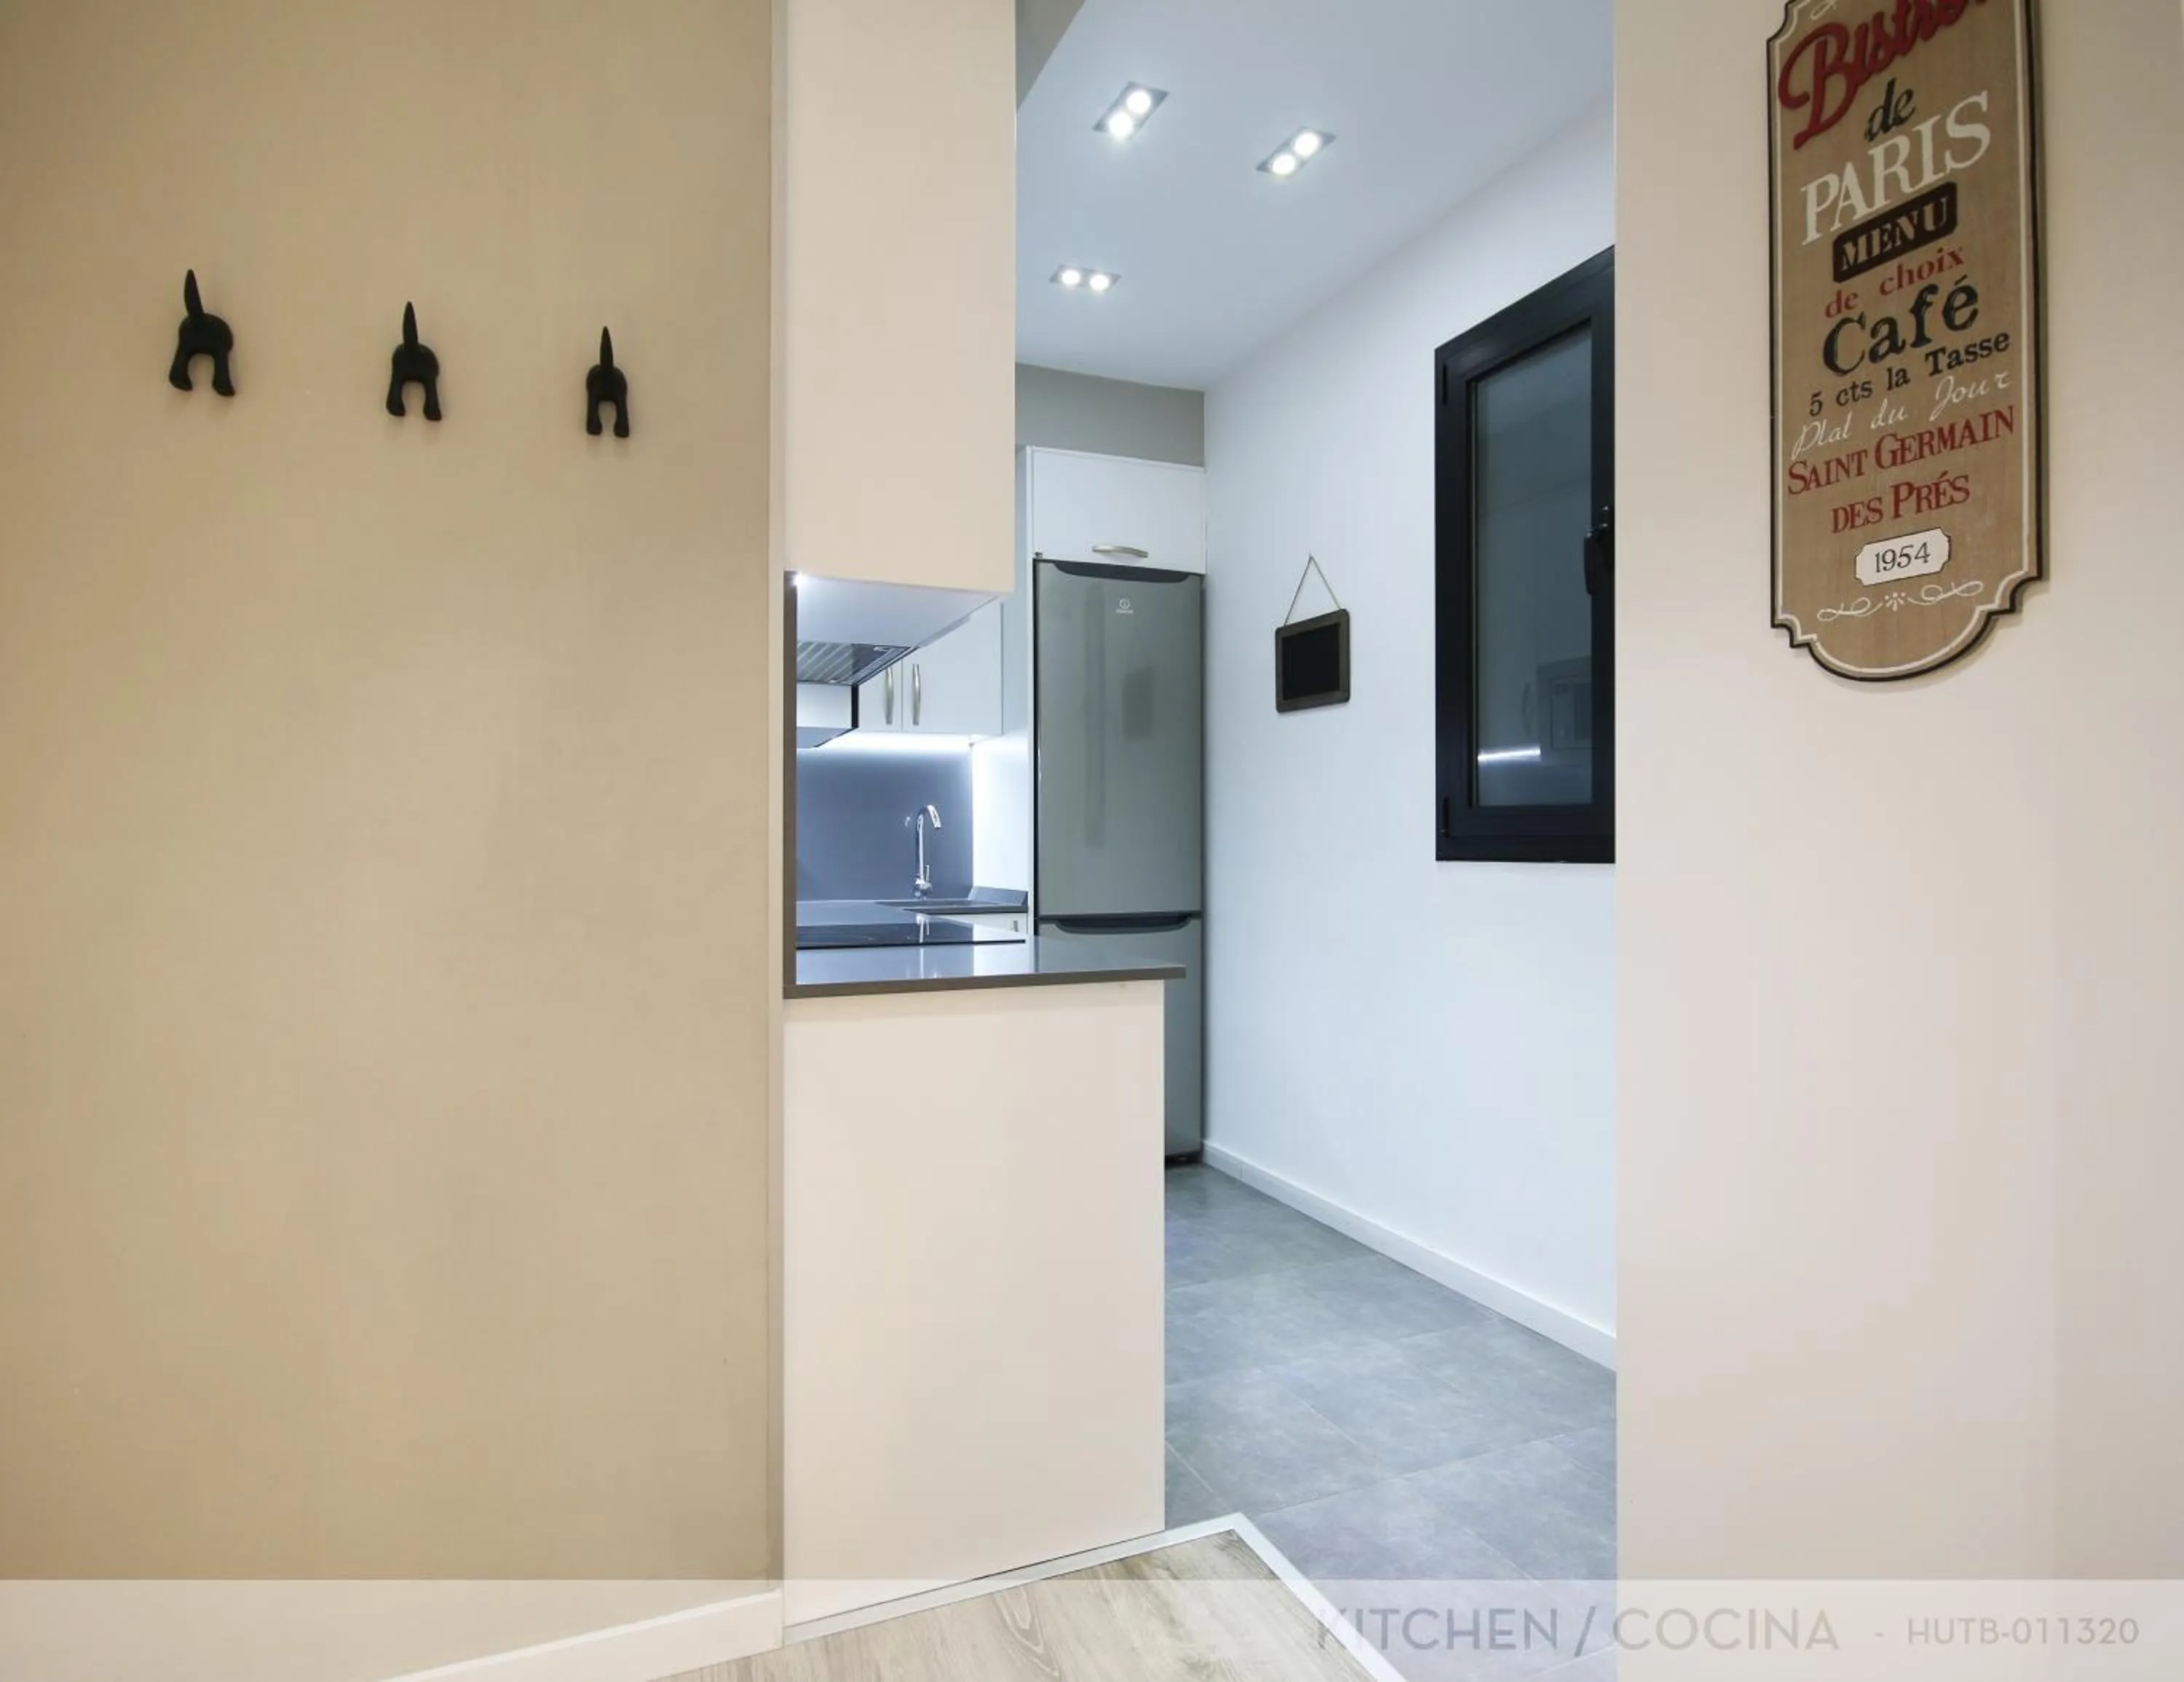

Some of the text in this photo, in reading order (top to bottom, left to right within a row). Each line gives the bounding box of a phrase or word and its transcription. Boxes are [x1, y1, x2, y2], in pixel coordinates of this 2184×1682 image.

[1864, 78, 1916, 142] de
[1800, 90, 1990, 245] PARIS
[1840, 195, 1950, 272] MENU
[1824, 245, 1965, 318] de choix
[1823, 275, 1979, 376] Café
[1809, 332, 2011, 417] 5 cts la Tasse
[1870, 398, 1909, 430] du
[1929, 371, 2011, 421] Jour
[1788, 406, 2015, 496] SAINT GERMAIN
[1875, 542, 1931, 573] 1954
